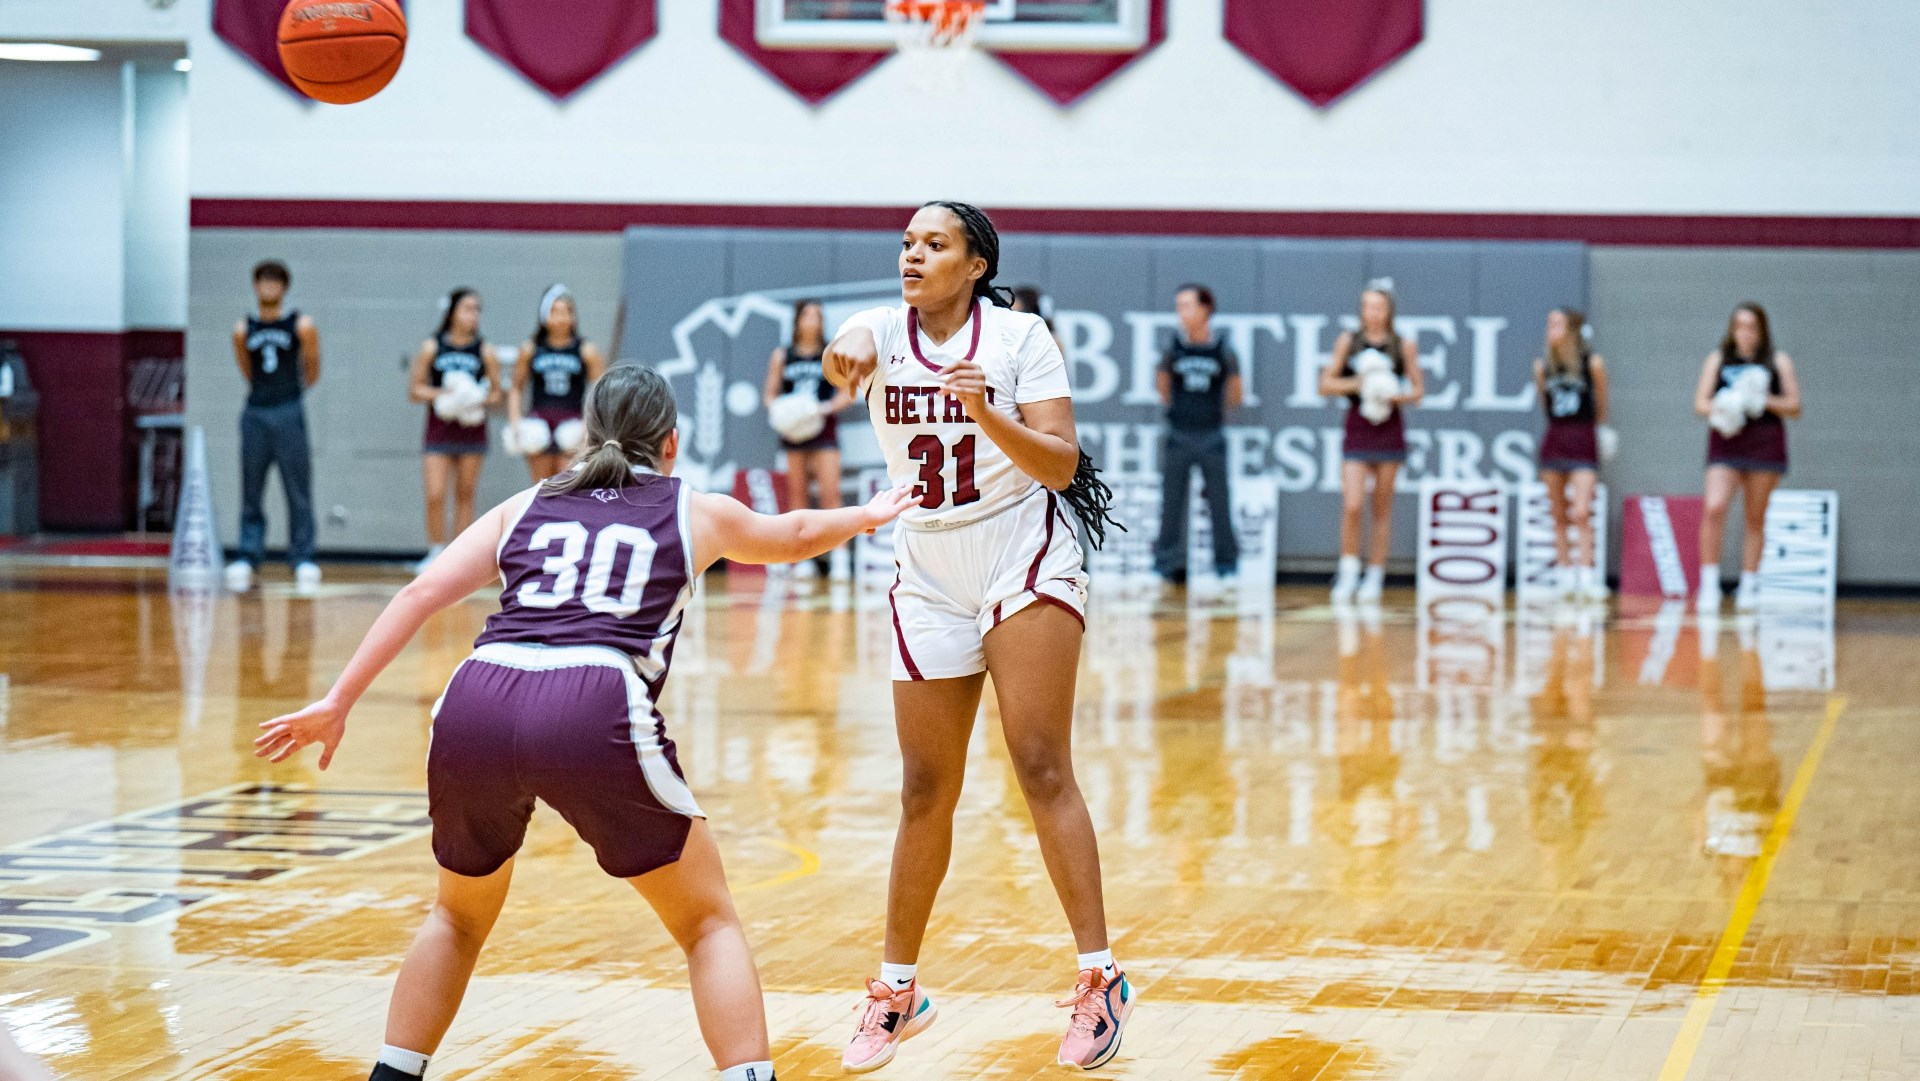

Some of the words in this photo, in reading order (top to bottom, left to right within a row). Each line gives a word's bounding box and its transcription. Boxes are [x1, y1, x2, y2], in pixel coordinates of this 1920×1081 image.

[885, 385, 996, 425] BETH
[908, 434, 981, 510] 31
[517, 520, 658, 620] 30
[1427, 488, 1499, 586] OUR
